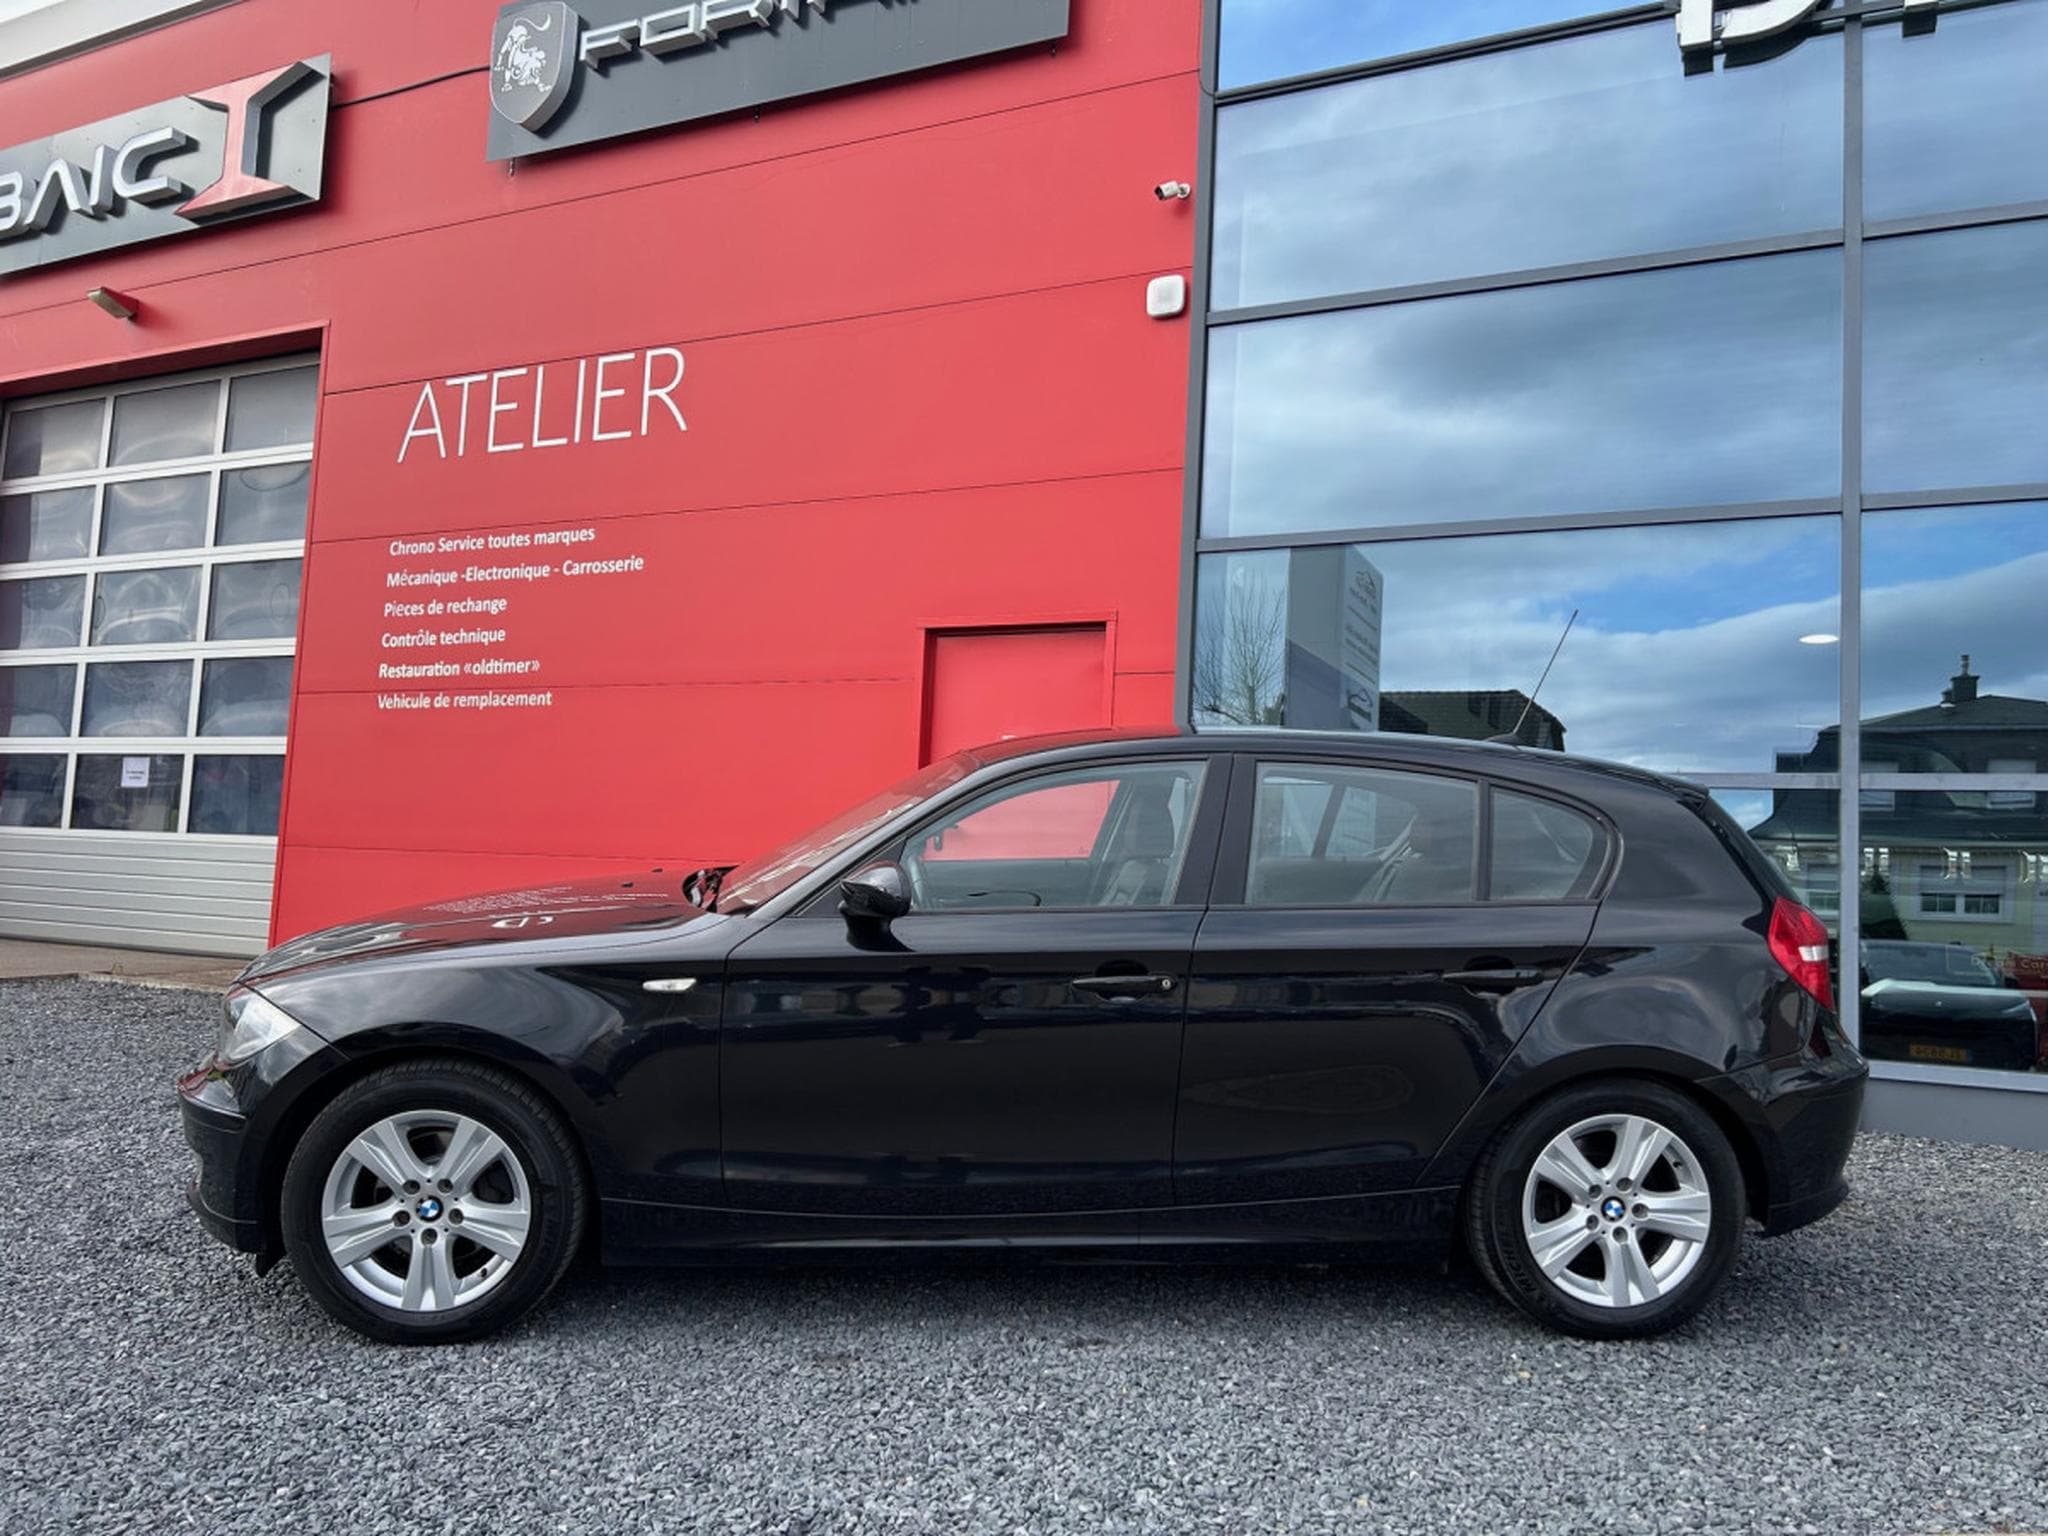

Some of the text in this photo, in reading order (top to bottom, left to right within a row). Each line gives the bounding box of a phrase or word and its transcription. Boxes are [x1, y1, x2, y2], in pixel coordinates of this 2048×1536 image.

[0, 126, 184, 234] BAIC
[397, 346, 688, 464] ATELIER
[389, 527, 596, 556] Chrono Service toutes marques
[386, 568, 458, 588] Mécanique
[562, 554, 644, 576] Carrosserie
[427, 598, 445, 615] de
[446, 596, 508, 615] rechange
[381, 627, 506, 648] Contrôle technique
[378, 661, 461, 679] Restauration
[433, 692, 451, 708] de
[453, 690, 553, 710] remplacement
